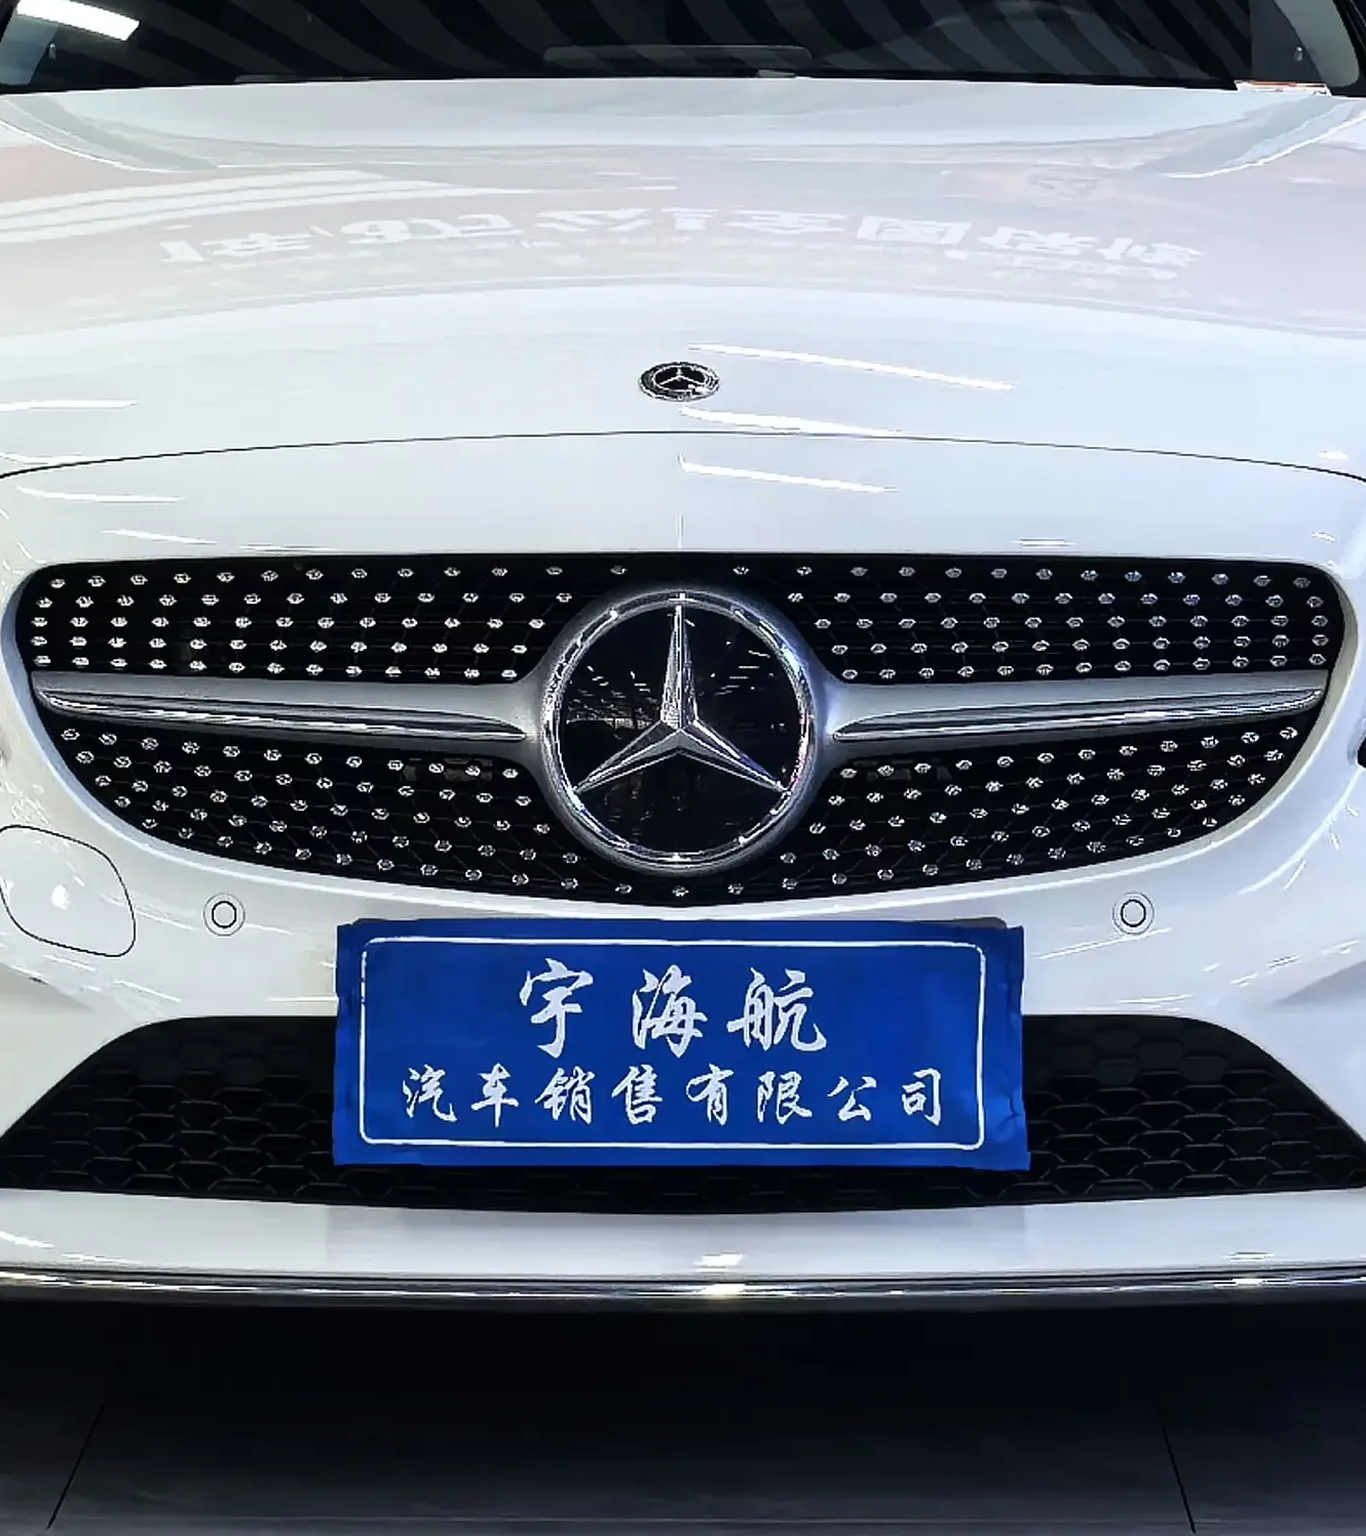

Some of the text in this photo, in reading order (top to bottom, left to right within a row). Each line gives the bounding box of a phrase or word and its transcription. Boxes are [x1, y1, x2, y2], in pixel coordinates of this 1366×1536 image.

[519, 958, 827, 1059] 宇海航
[402, 1063, 943, 1127] 汽车销售有限公司
